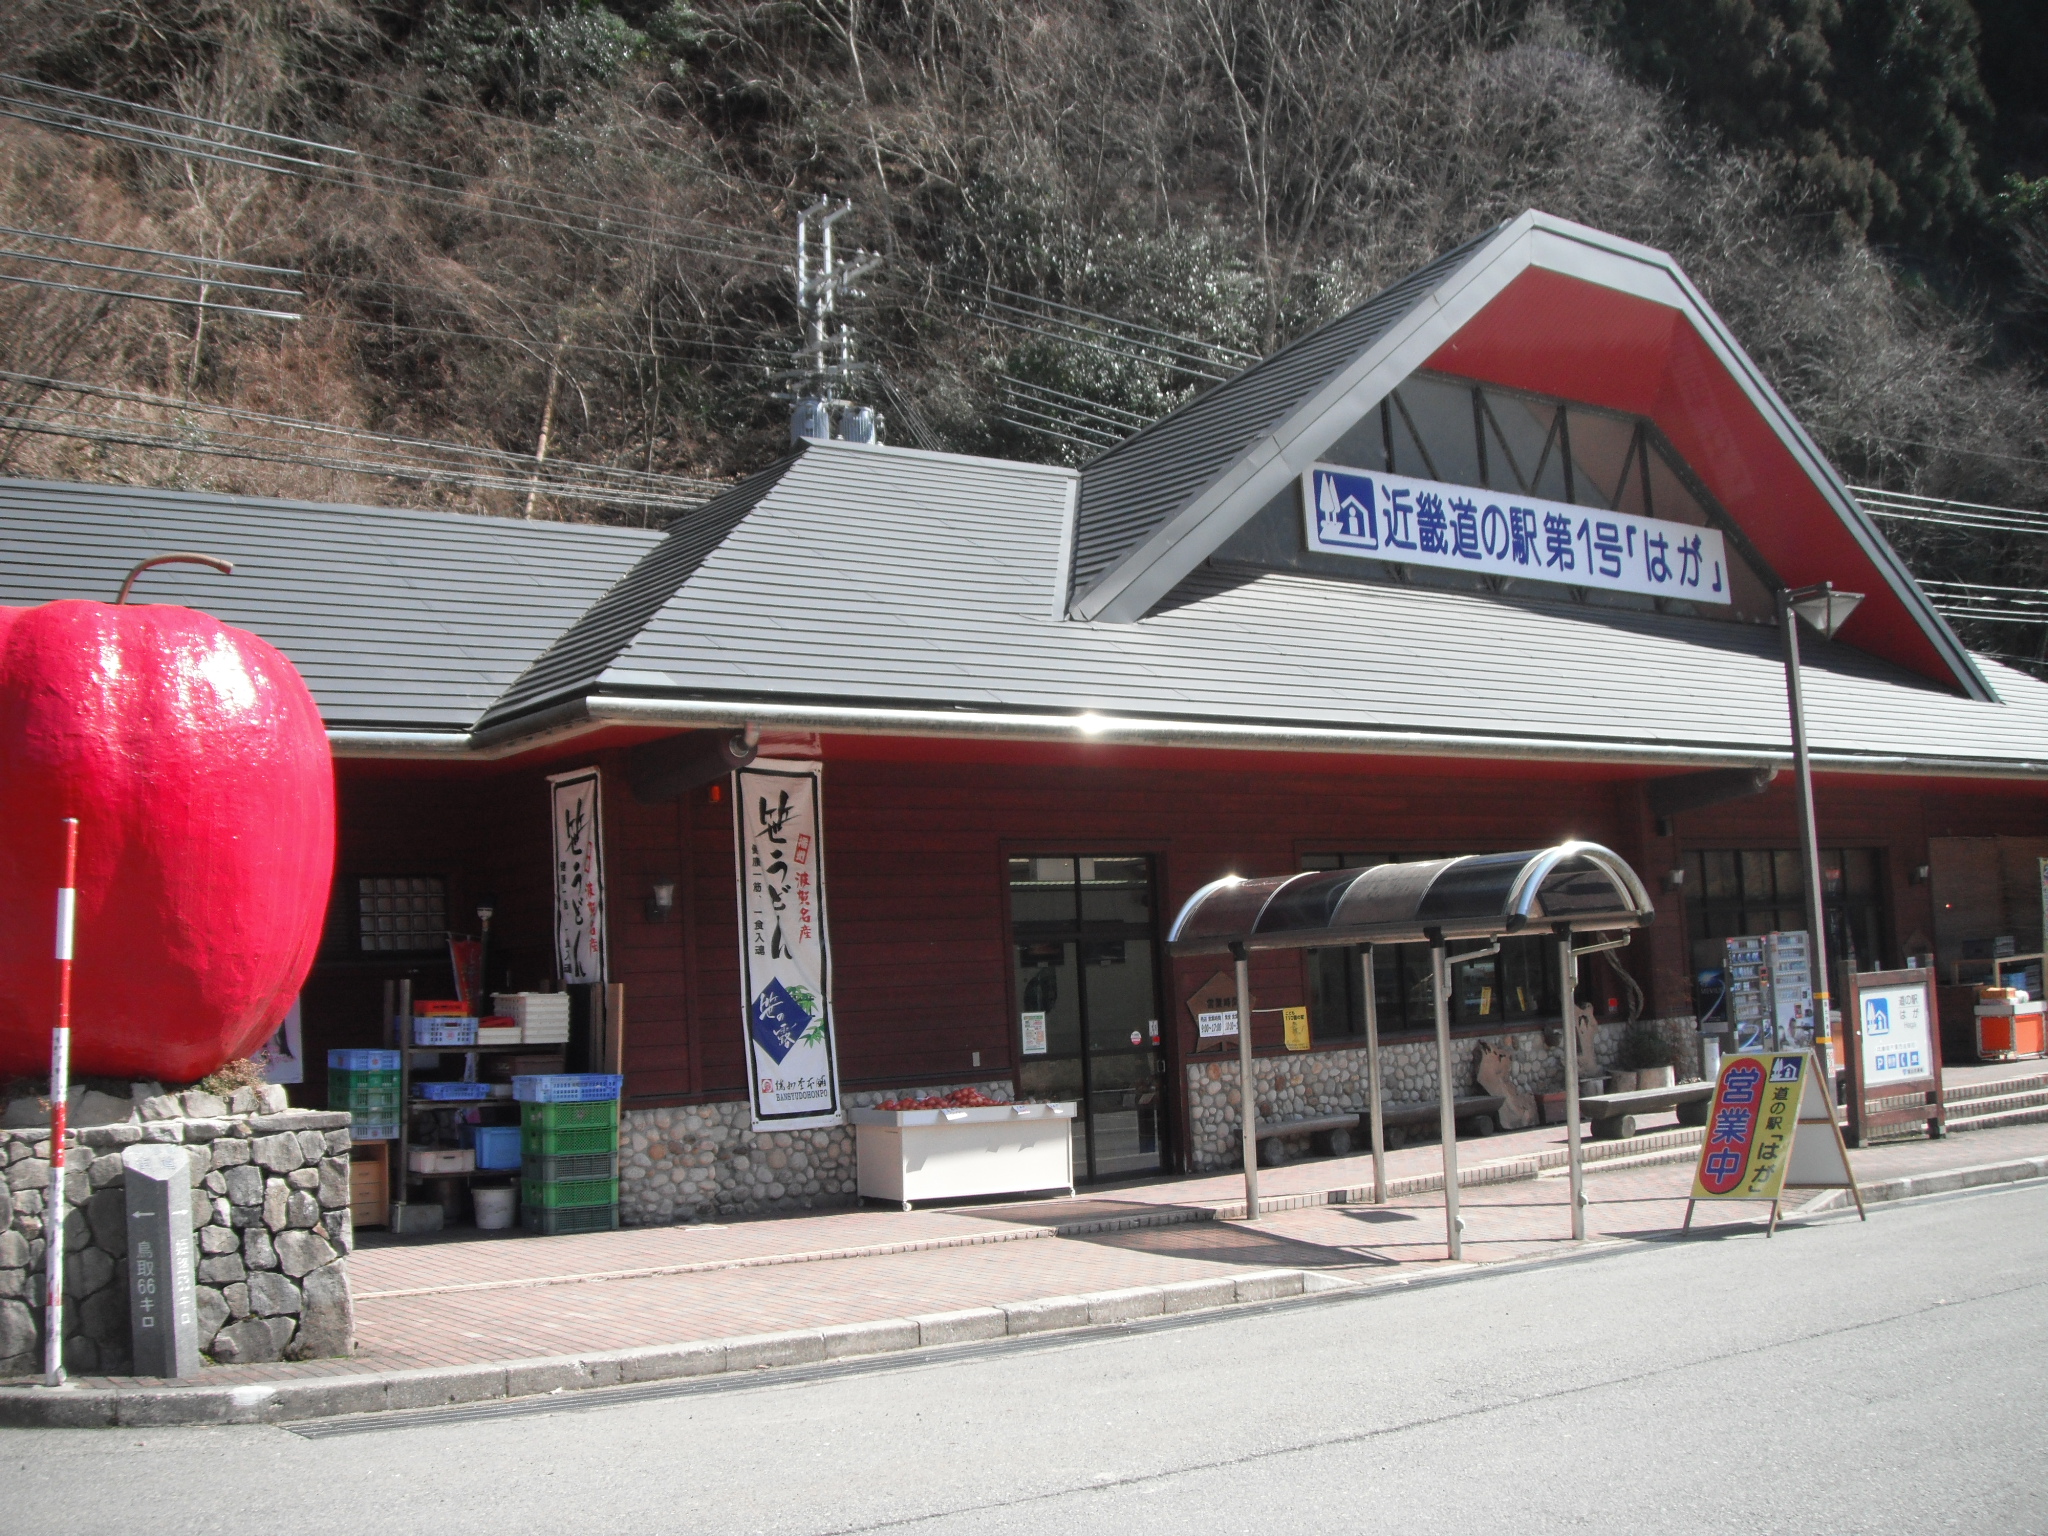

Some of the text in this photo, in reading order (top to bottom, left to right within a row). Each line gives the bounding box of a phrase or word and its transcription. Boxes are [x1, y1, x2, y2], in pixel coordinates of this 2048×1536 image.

[565, 798, 590, 978] 笹うどん
[755, 790, 801, 959] 笹うどん
[795, 871, 812, 944] 波賀名産
[1898, 994, 1918, 1006] 道の駅
[1705, 1067, 1760, 1184] 営業中
[1748, 1087, 1790, 1193] 道の駅「はが」
[136, 1240, 156, 1328] 鳥取66キロ
